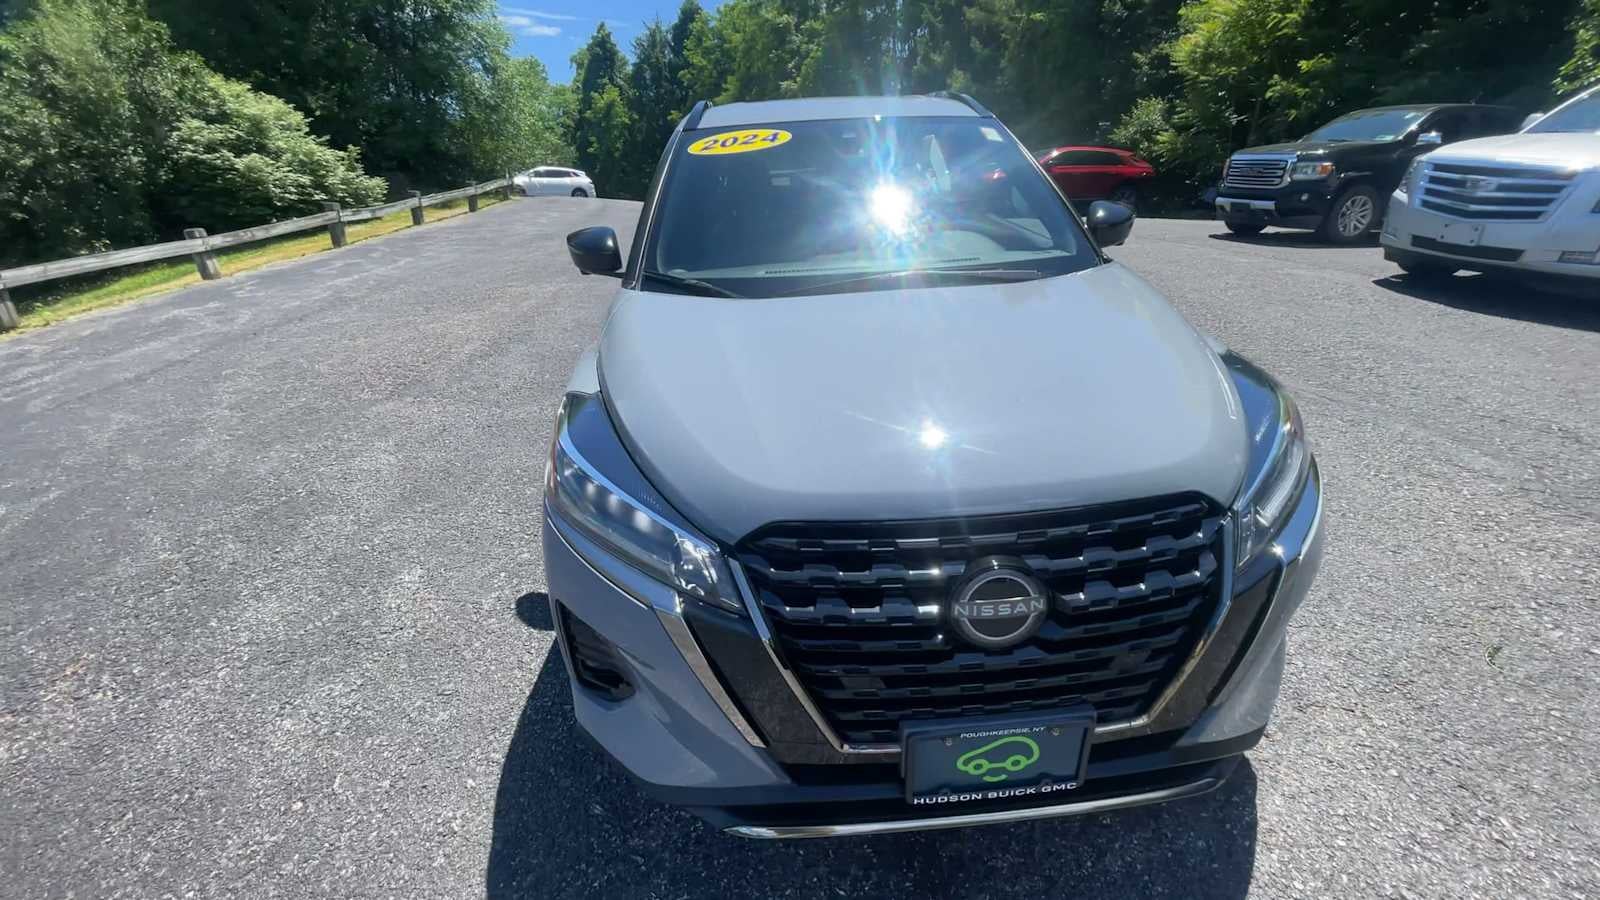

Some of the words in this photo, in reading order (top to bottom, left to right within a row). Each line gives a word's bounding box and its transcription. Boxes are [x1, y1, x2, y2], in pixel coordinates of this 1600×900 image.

[701, 132, 780, 151] 2024
[954, 599, 1044, 616] NISSAN
[913, 793, 982, 805] HUDSON
[987, 787, 1036, 799] BUICK
[1041, 782, 1077, 793] GMC
